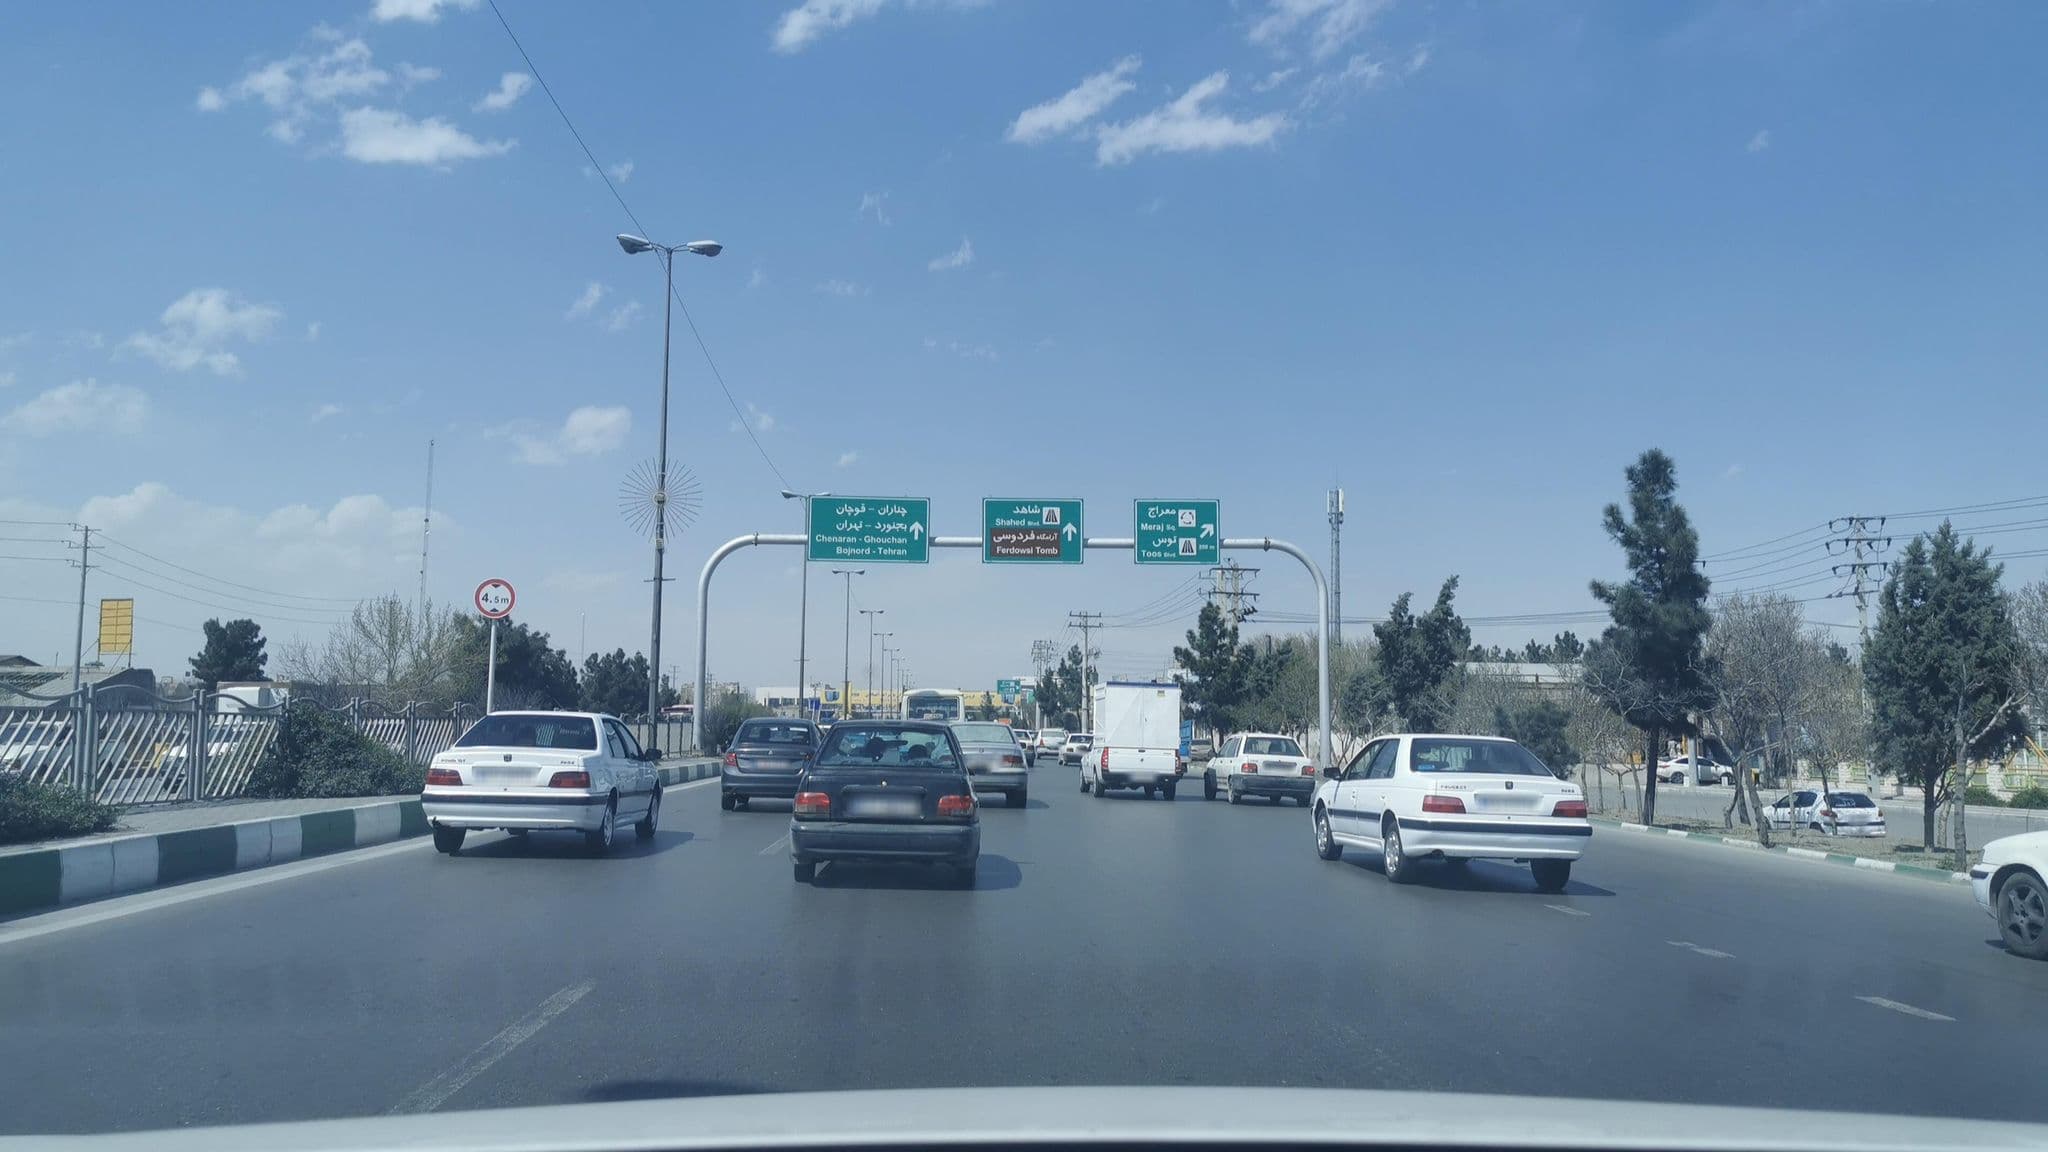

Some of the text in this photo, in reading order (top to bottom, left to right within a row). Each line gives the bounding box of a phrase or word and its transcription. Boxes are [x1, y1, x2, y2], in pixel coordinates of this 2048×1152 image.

[836, 503, 866, 516] قوچان
[878, 504, 908, 517] چناران
[1013, 505, 1040, 514] شاهد
[1148, 505, 1177, 519] معراج
[836, 520, 863, 532] تهران
[875, 521, 908, 533] بجنورد
[995, 518, 1026, 527] Shahed
[1140, 522, 1164, 532] Meraj
[815, 534, 857, 543] Chenaran
[863, 535, 908, 544] Ghouchan
[993, 530, 1036, 543] فردوسی
[1152, 536, 1178, 548] توس
[836, 547, 871, 556] Bojnord
[878, 547, 908, 556] Tehran
[996, 546, 1058, 555] Ferdowsi Tomb
[1141, 550, 1162, 558] Toos
